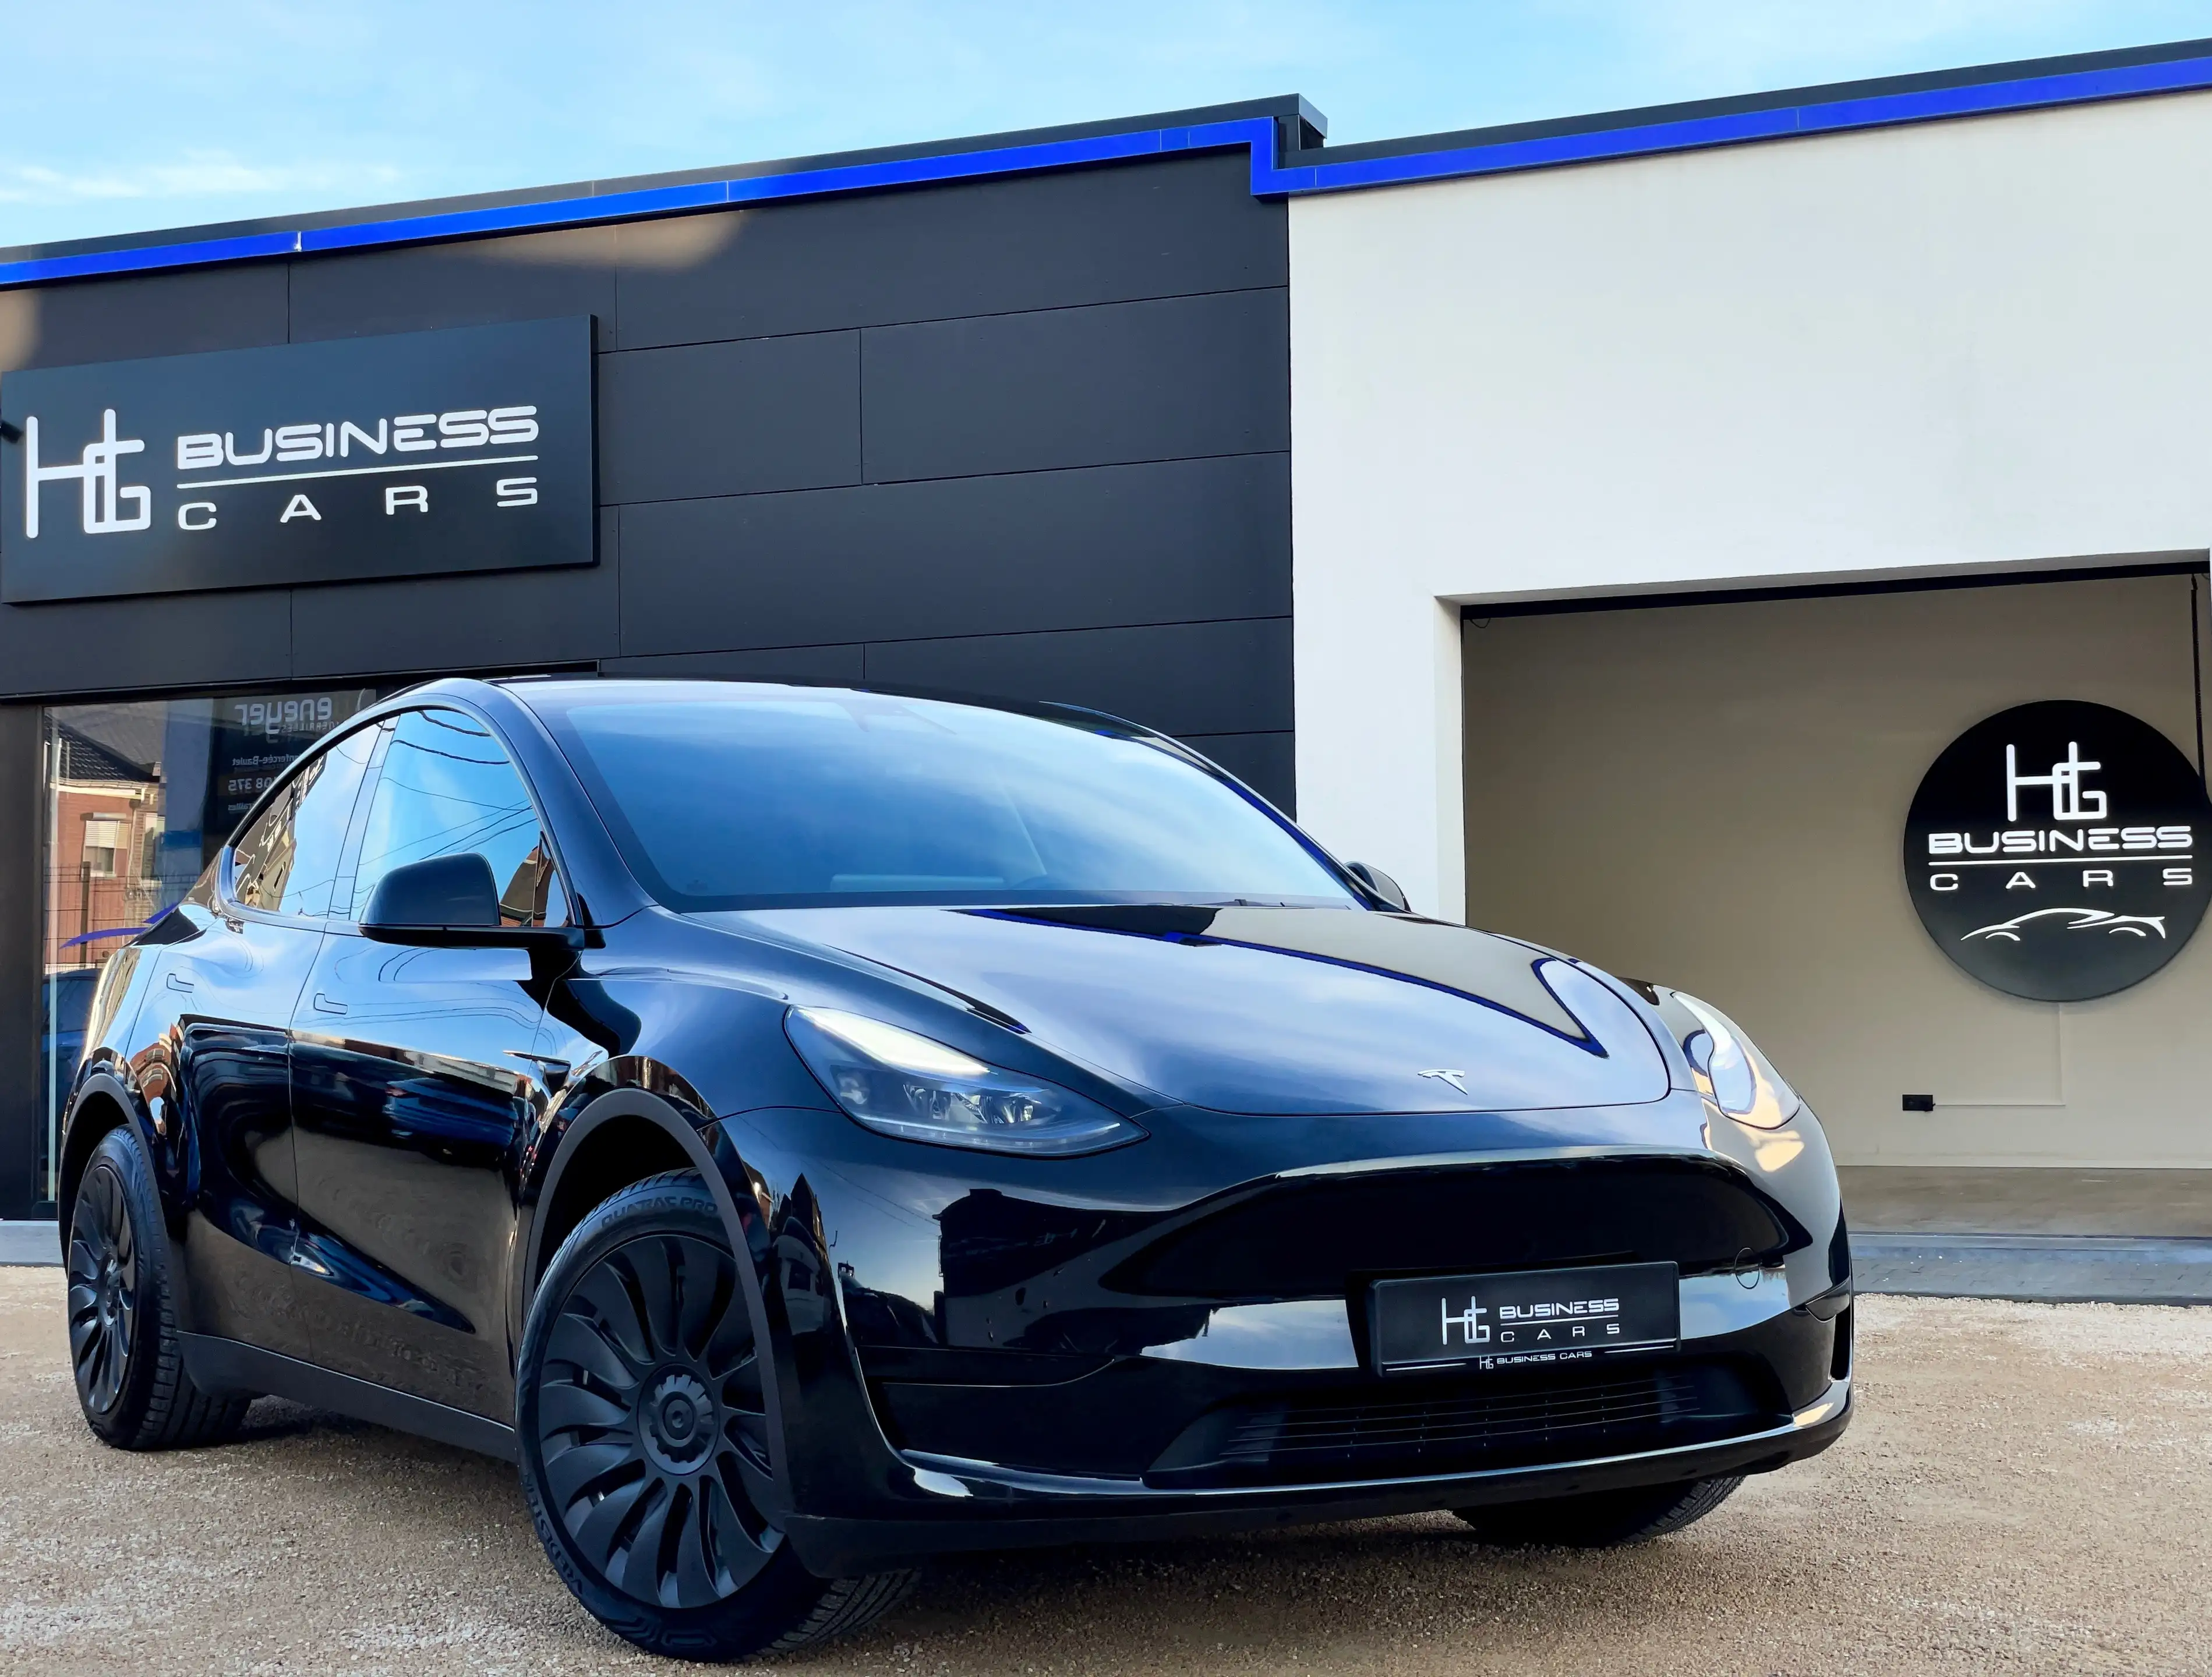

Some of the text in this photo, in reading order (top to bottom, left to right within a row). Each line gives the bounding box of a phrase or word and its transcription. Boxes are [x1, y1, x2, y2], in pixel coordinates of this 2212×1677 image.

[177, 405, 539, 470] BUSINESS
[178, 477, 538, 530] CARS
[1928, 826, 2193, 854] BUSINESS
[1930, 868, 2193, 891] CARS
[680, 1197, 718, 1215] PRO
[1499, 1298, 1620, 1319] BUSINESS
[1500, 1323, 1620, 1343] CARS
[1496, 1353, 1556, 1364] BUSINESS
[1559, 1350, 1592, 1360] CARS
